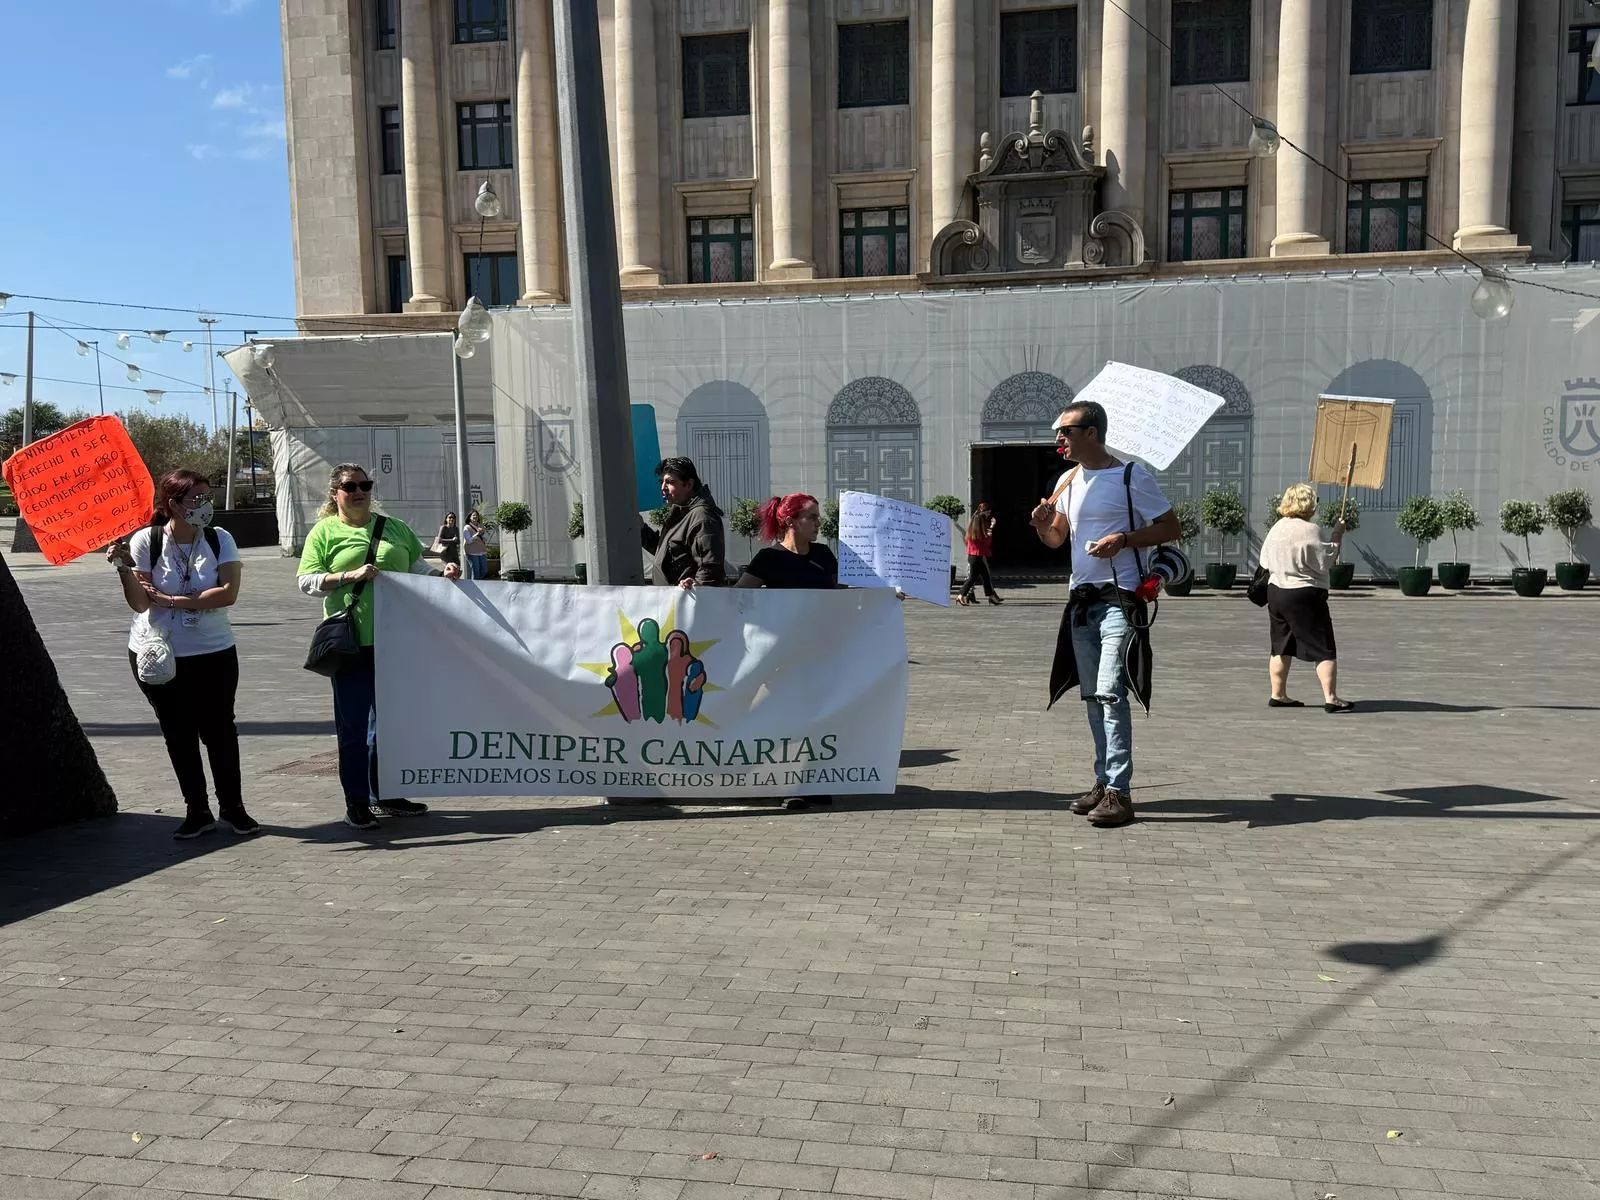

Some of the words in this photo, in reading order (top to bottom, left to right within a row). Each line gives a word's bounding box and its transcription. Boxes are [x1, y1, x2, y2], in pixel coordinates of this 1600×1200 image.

[60, 423, 95, 444] TIENE
[1543, 406, 1566, 466] CABILDO
[1570, 461, 1590, 472] DE
[13, 454, 64, 484] DERECHO
[70, 447, 80, 458] A
[83, 433, 109, 451] SER
[72, 463, 91, 478] LOS
[25, 477, 97, 514] CEDIMIENTOS
[78, 501, 88, 512] O
[40, 516, 103, 546] TRATIVOS
[111, 498, 140, 516] QUE
[52, 547, 77, 564] LES
[449, 730, 629, 764] DENIPER
[640, 734, 838, 766] CANARIAS
[400, 768, 552, 785] DEFENDEMOS
[557, 769, 597, 785] LOS
[603, 771, 714, 787] DERECHOS
[720, 772, 747, 787] DE
[752, 771, 777, 786] LA
[783, 767, 881, 786] INFANCIA
